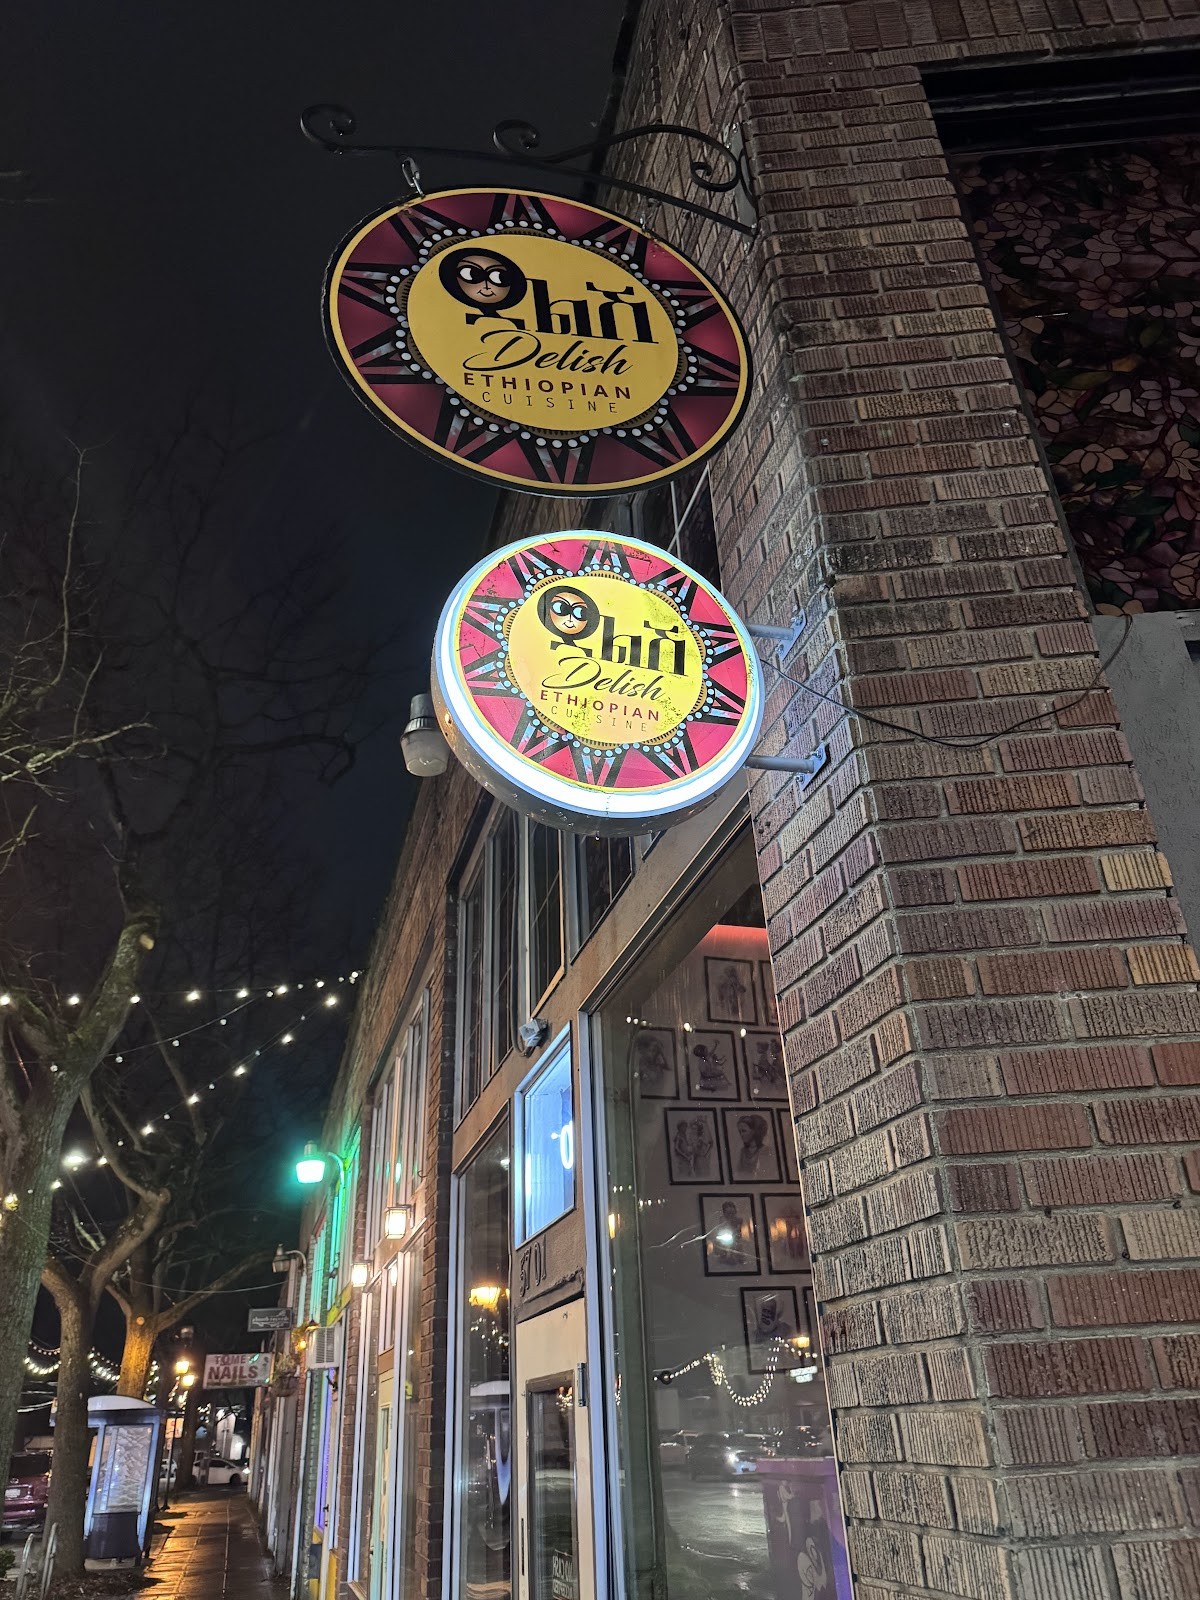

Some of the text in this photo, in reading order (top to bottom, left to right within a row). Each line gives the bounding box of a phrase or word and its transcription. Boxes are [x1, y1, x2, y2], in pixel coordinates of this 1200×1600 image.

[462, 329, 633, 376] Delish
[463, 372, 631, 400] ETHIOPIAN
[482, 391, 617, 413] CUISINE
[541, 656, 666, 701] Delish
[540, 689, 660, 722] ETHIOPIAN
[551, 705, 647, 732] CUISINE
[208, 1366, 259, 1380] NAILS
